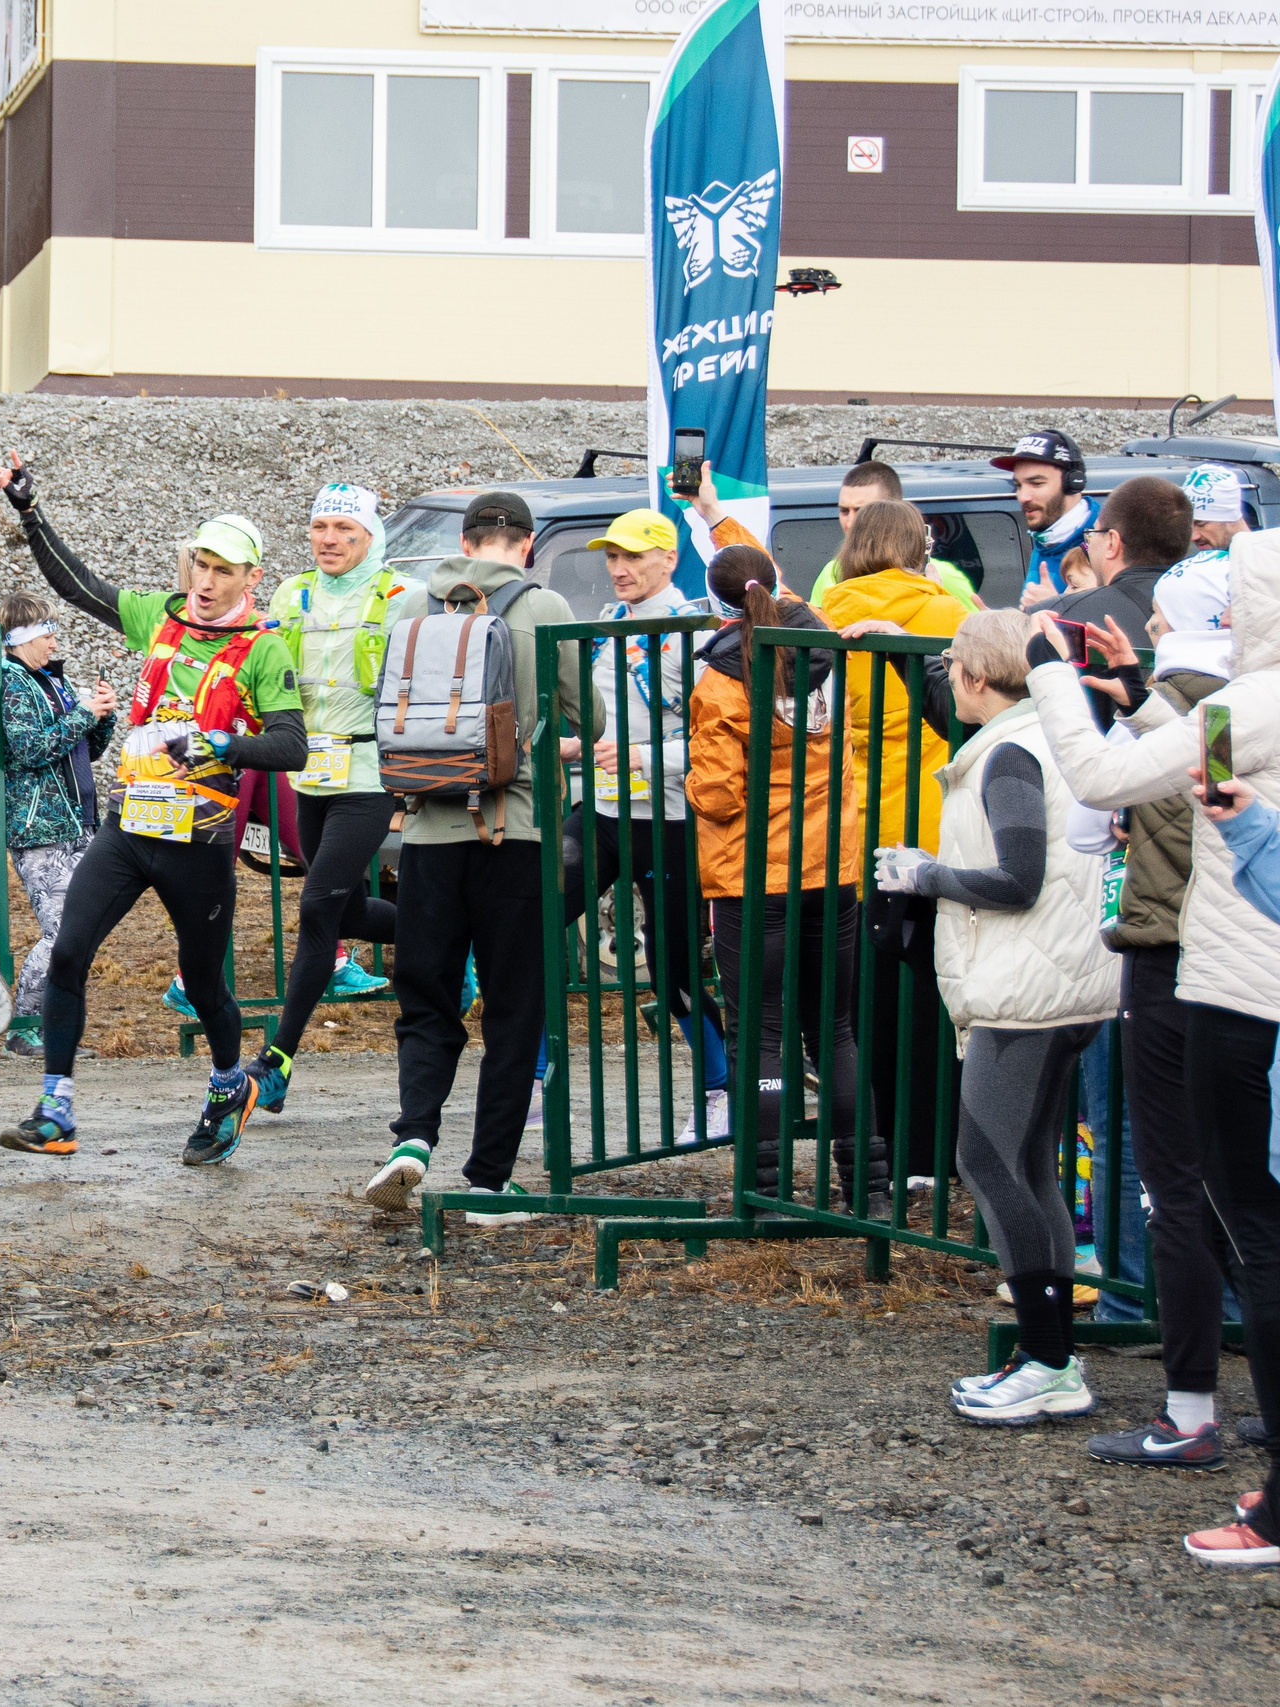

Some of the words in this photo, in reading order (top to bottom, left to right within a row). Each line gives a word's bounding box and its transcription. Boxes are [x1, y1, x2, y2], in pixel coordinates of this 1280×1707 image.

[635, 0, 674, 13] ООО
[887, 3, 998, 21] ЗАСТРОЙЩИК
[1113, 8, 1202, 24] ПРОЕКТНАЯ
[662, 309, 774, 363] ХЕХЦИР
[127, 801, 188, 822] 02037
